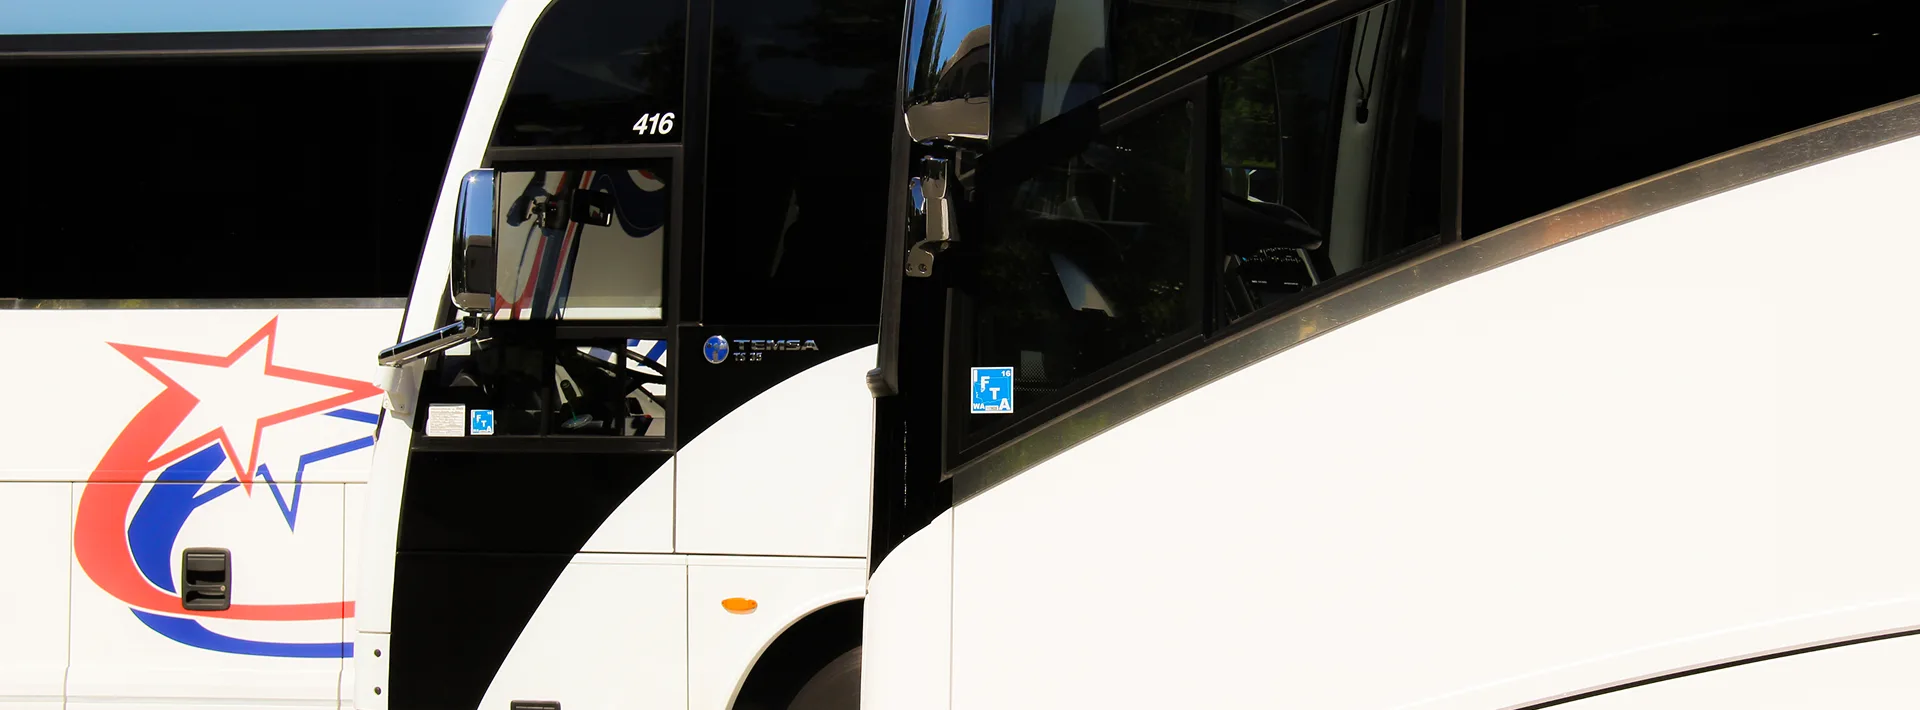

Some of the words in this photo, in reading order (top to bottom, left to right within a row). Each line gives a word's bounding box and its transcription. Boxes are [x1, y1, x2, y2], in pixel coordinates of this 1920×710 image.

[632, 112, 675, 135] 416
[733, 339, 819, 350] TEMSA
[733, 352, 746, 361] TS
